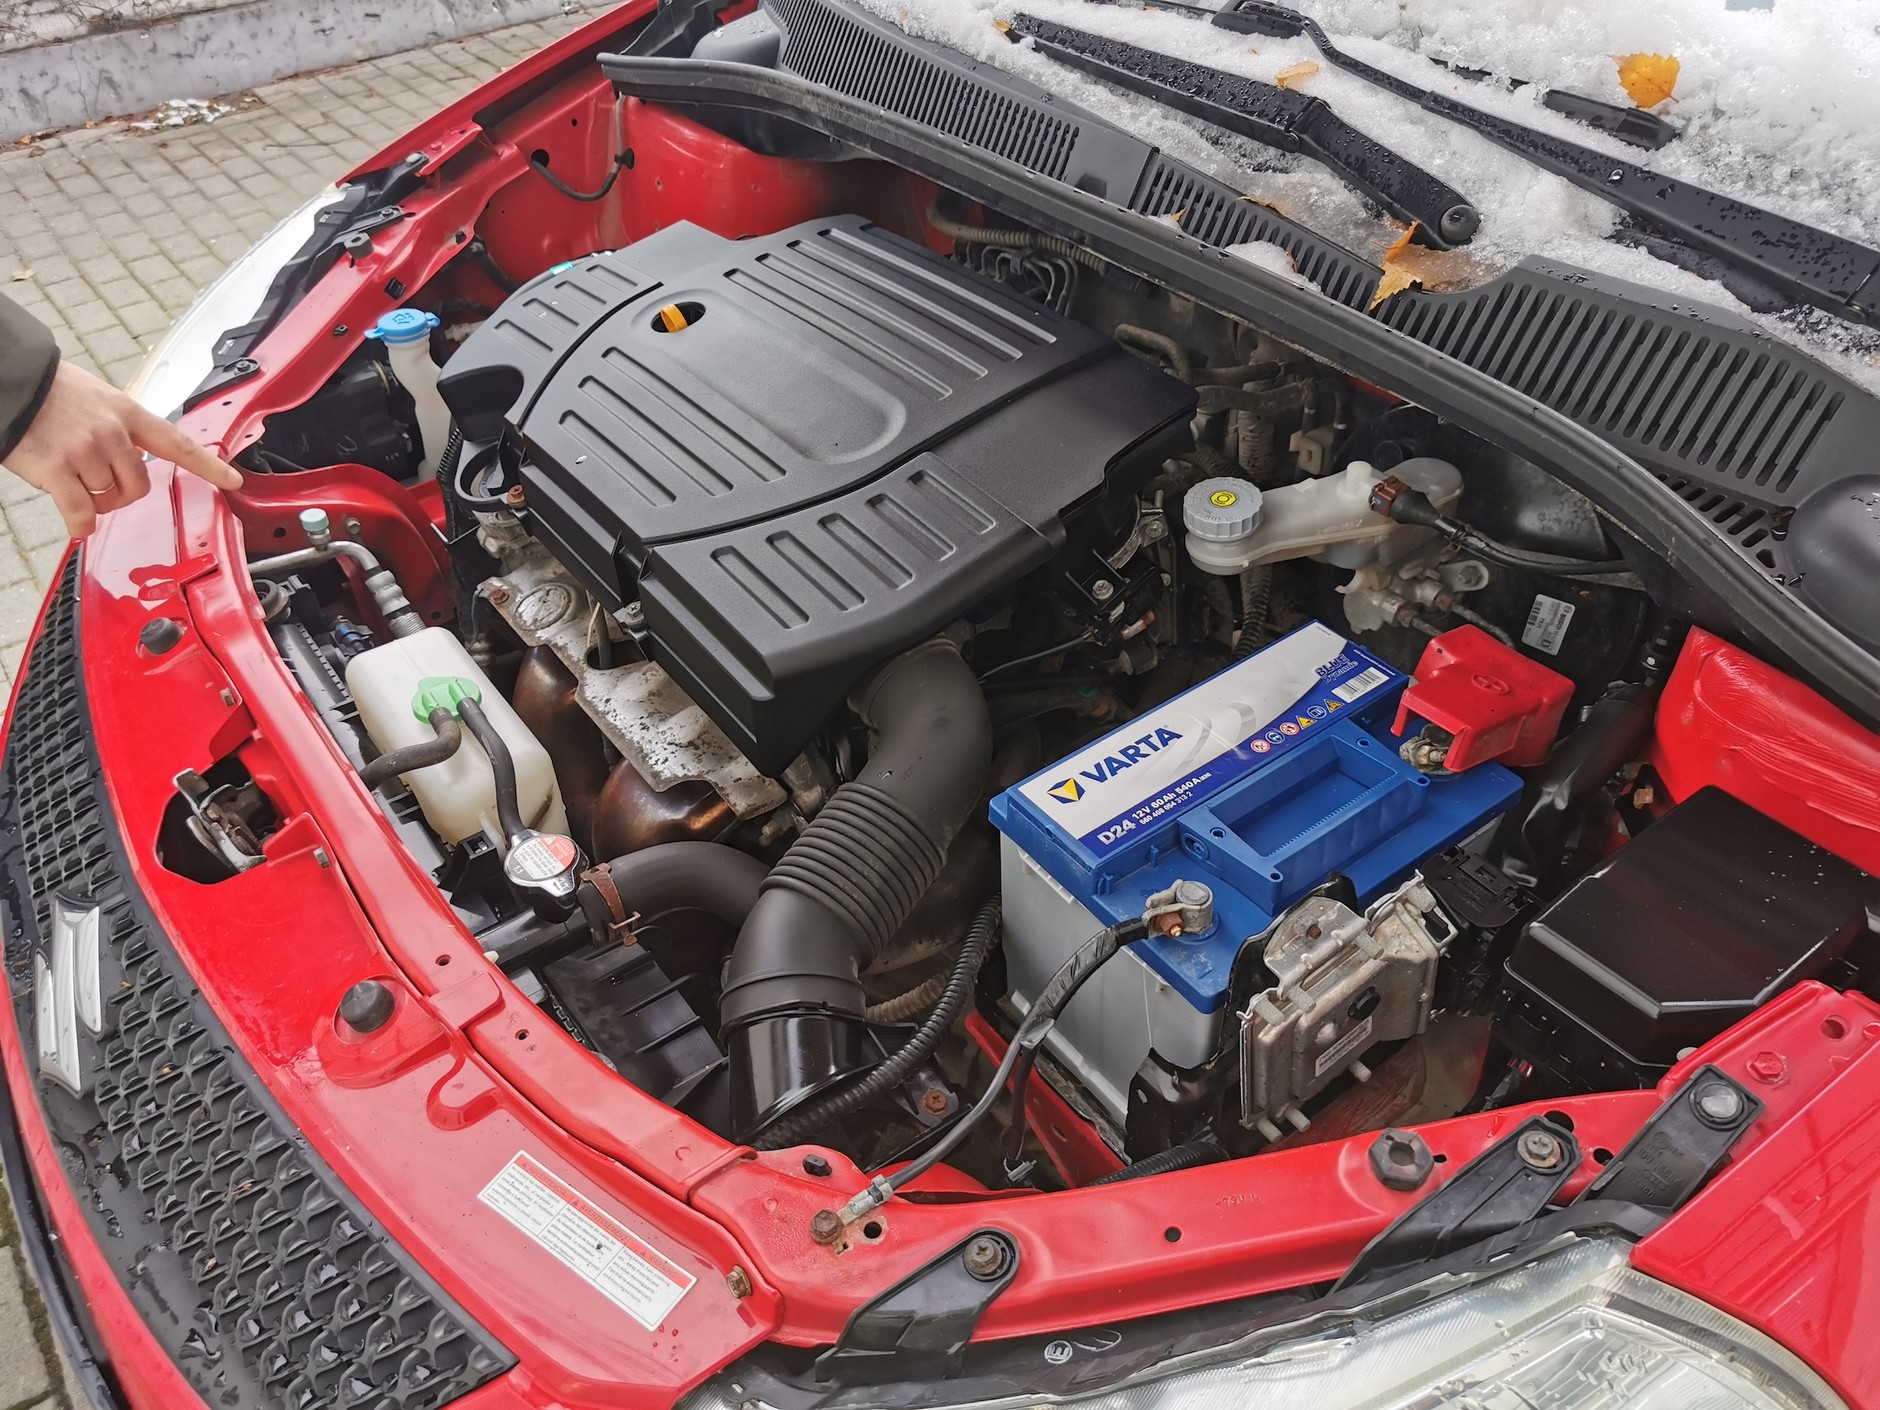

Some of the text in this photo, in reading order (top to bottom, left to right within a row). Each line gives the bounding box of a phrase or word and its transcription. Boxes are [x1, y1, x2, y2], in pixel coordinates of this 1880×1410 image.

[1315, 653, 1350, 678] BLUE
[1079, 727, 1184, 783] VARTA
[1131, 805, 1151, 820] 12V
[1150, 791, 1177, 810] 60Ah
[1163, 801, 1177, 812] 054
[1174, 795, 1188, 805] 313
[1097, 819, 1137, 846] D24
[579, 1203, 628, 1241] AVERTISSEMENT
